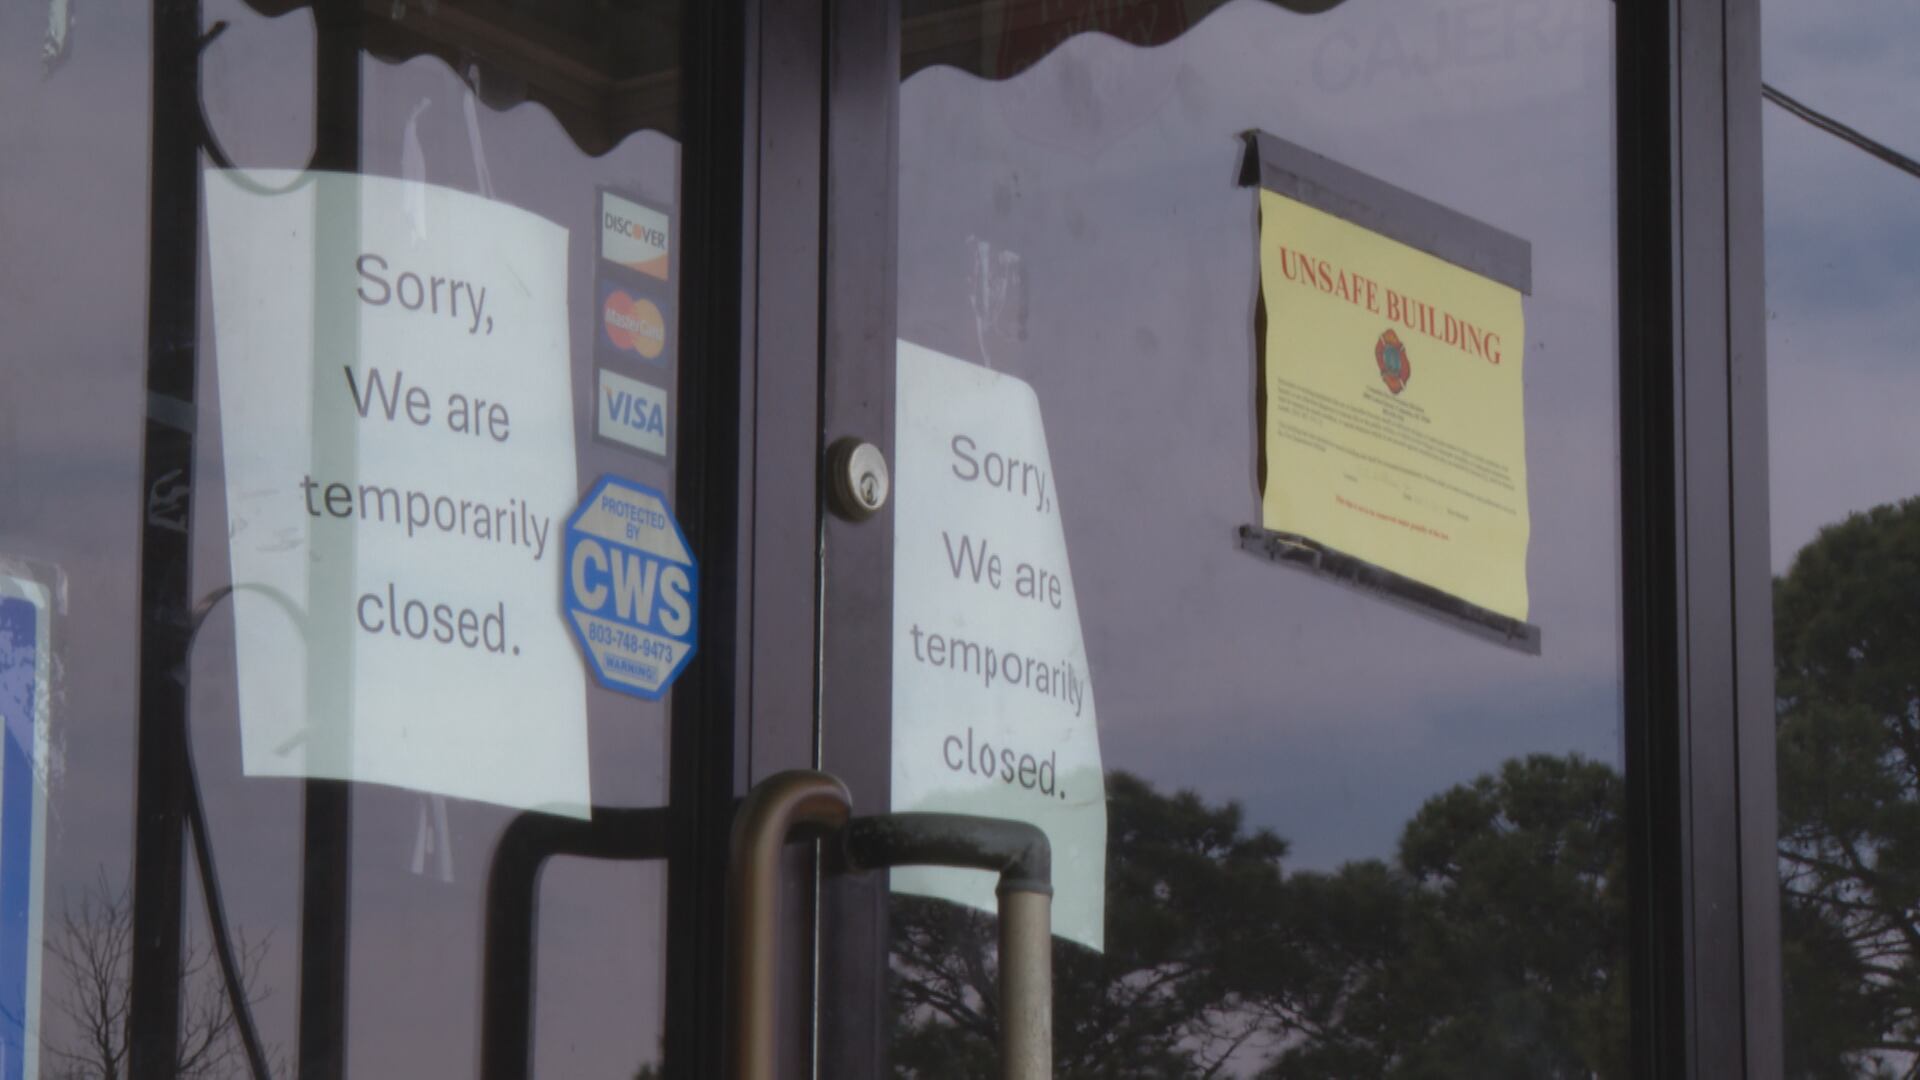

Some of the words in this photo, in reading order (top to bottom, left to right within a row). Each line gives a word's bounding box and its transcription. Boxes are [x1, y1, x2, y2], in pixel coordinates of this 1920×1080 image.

[604, 212, 667, 250] DISCOVER
[355, 253, 494, 335] Sorry,
[1279, 245, 1381, 315] UNSAFE
[1385, 288, 1502, 366] BUILDING
[342, 365, 432, 427] We
[447, 392, 510, 443] are
[604, 389, 665, 437] VISA
[950, 434, 1051, 514] Sorry,
[299, 474, 550, 561] temporarily
[602, 496, 665, 531] PROTECTED
[626, 524, 641, 541] BY
[571, 538, 692, 637] CWS
[942, 530, 1002, 590] We
[1015, 562, 1062, 610] are
[356, 582, 521, 656] closed.
[588, 622, 673, 664] 803-748-9473
[909, 623, 1084, 718] temporarily
[942, 726, 1066, 800] closed.
